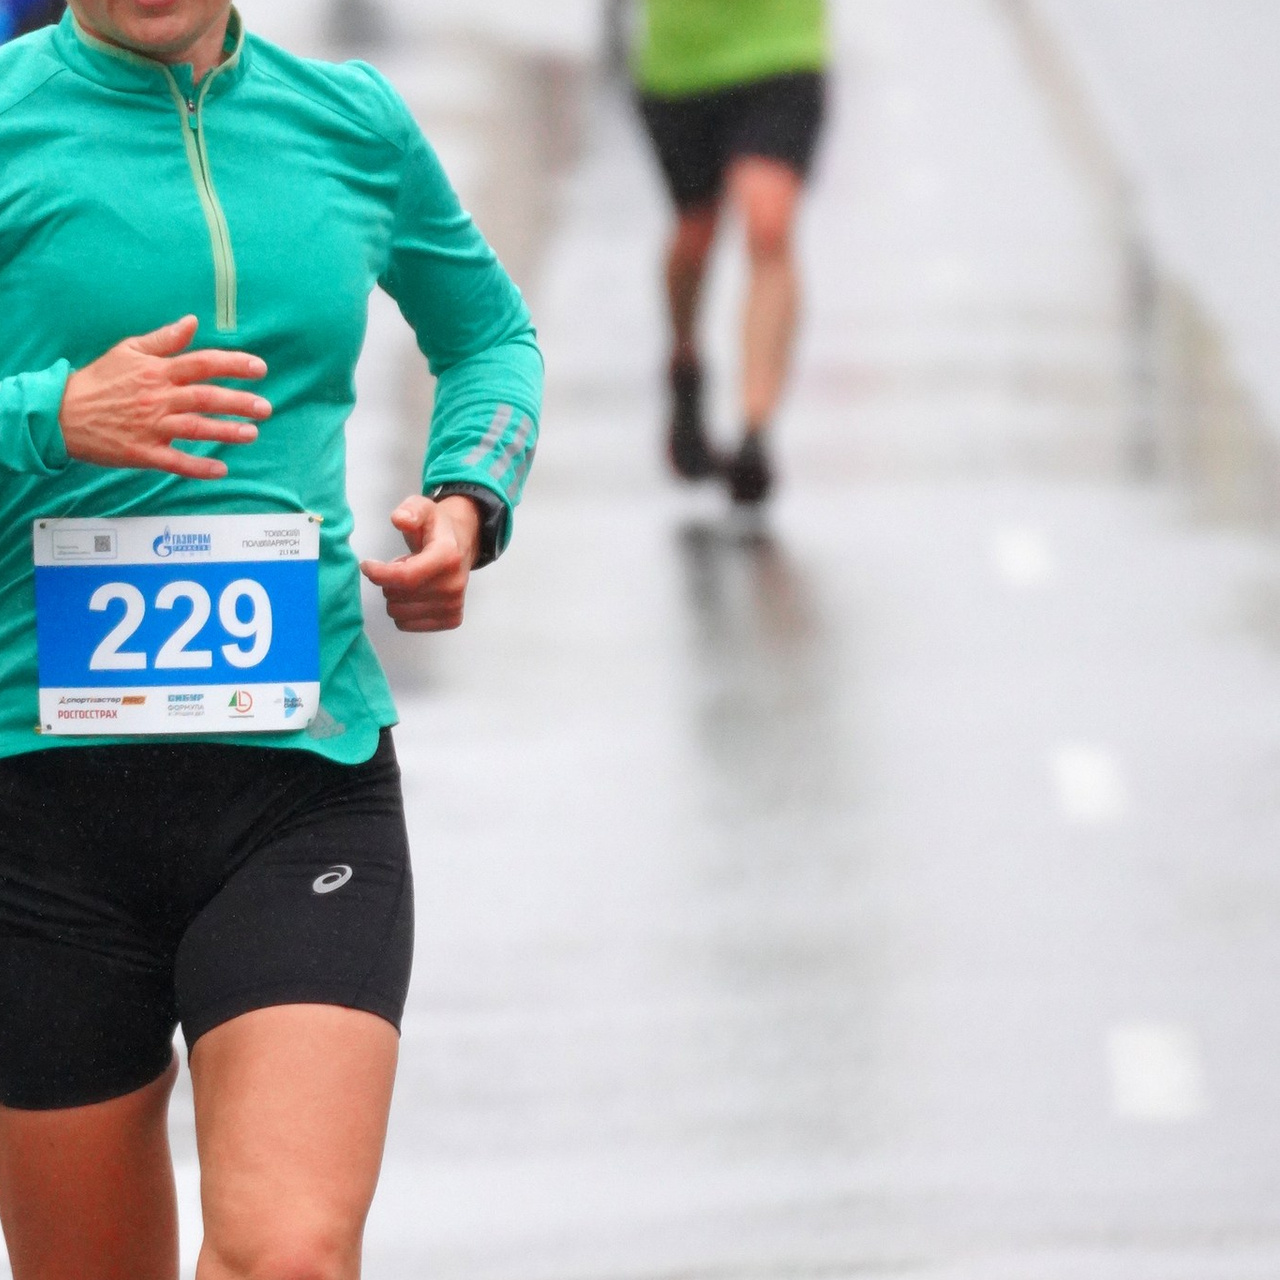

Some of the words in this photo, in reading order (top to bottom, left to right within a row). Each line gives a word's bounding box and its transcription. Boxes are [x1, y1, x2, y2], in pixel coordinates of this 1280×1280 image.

[172, 533, 211, 544] ГАЗПРОМ
[89, 578, 273, 671] 229
[58, 710, 118, 719] РОСГОССТРАХ
